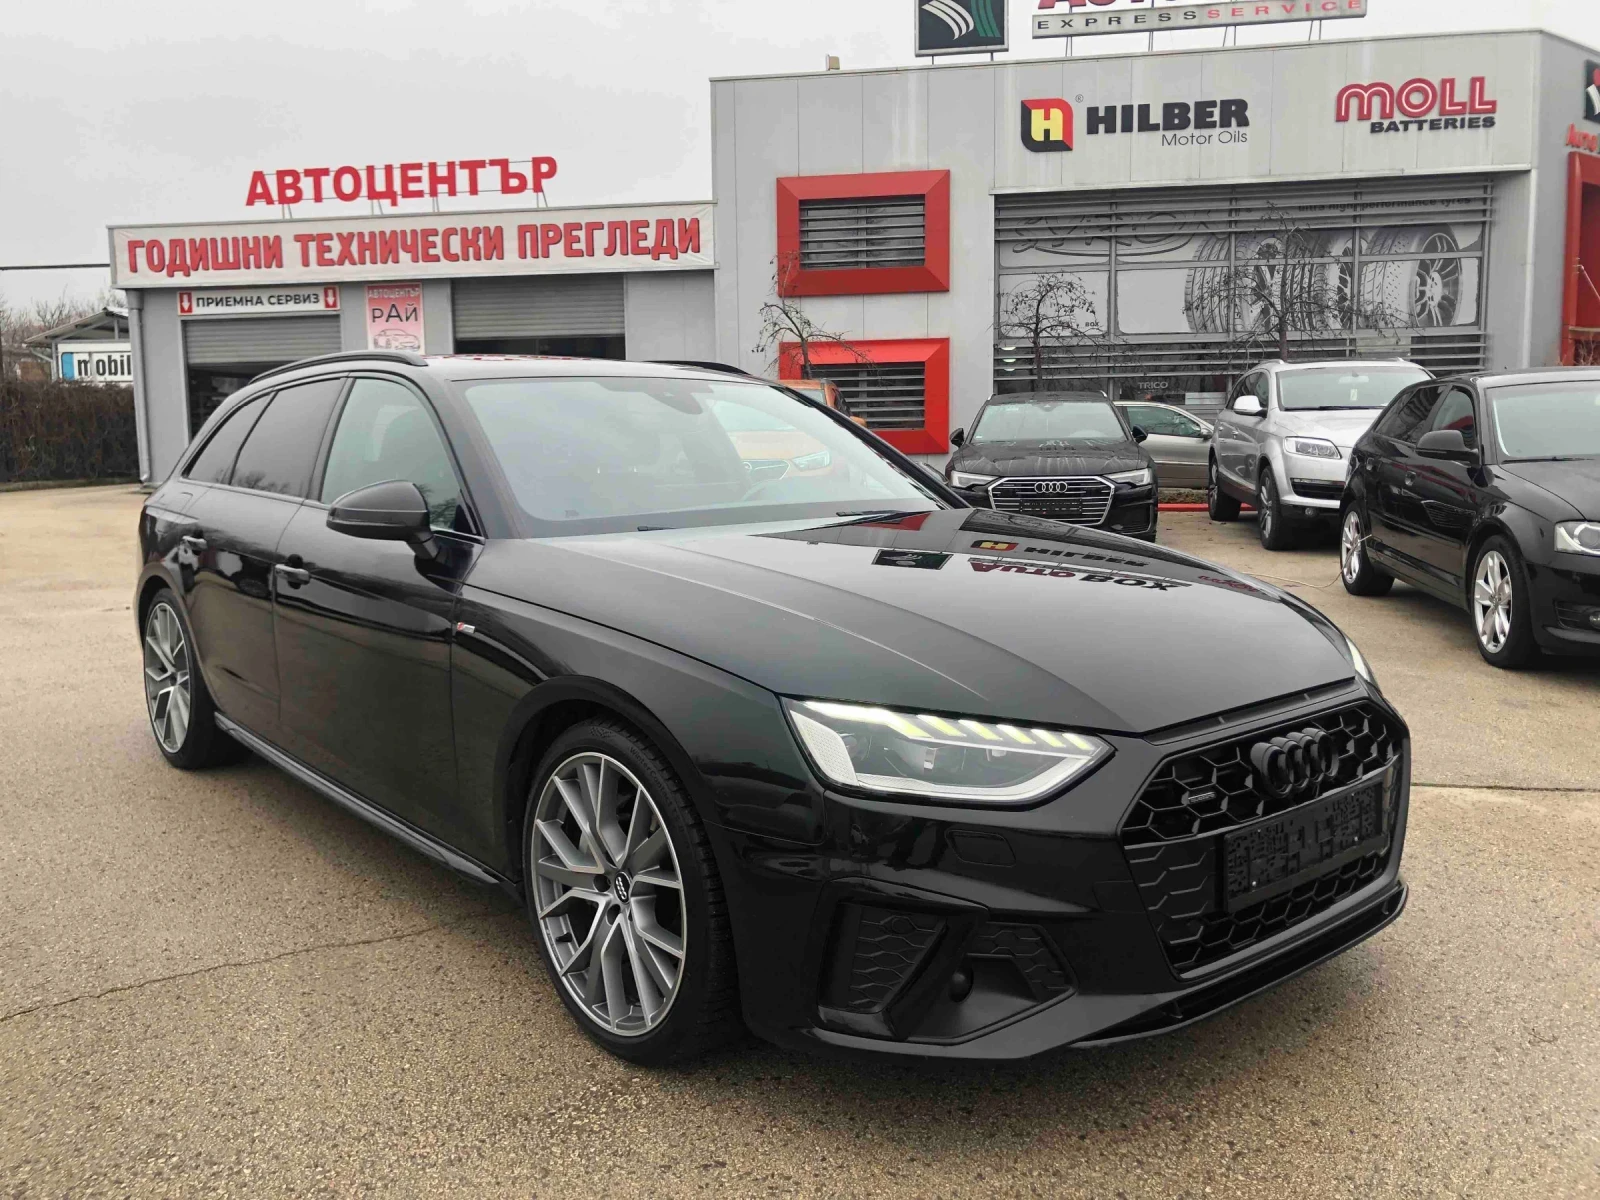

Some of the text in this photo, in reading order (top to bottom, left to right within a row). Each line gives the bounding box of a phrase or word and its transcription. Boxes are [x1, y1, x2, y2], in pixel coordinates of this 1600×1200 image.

[1086, 98, 1250, 135] HILBER
[1370, 116, 1496, 134] BATTERIES
[1161, 130, 1248, 147] Motor Oils
[245, 156, 557, 207] АВТОЦЕНТЪР
[127, 217, 702, 278] ГОДИШНИ ТЕХНИЧЕСКИ ПРЕГЛЕДИ
[196, 293, 320, 308] ПРИЕМНА СЕРВИЗ
[368, 287, 420, 299] АВТОЦЕНТЪР
[1138, 381, 1169, 389] TRICO
